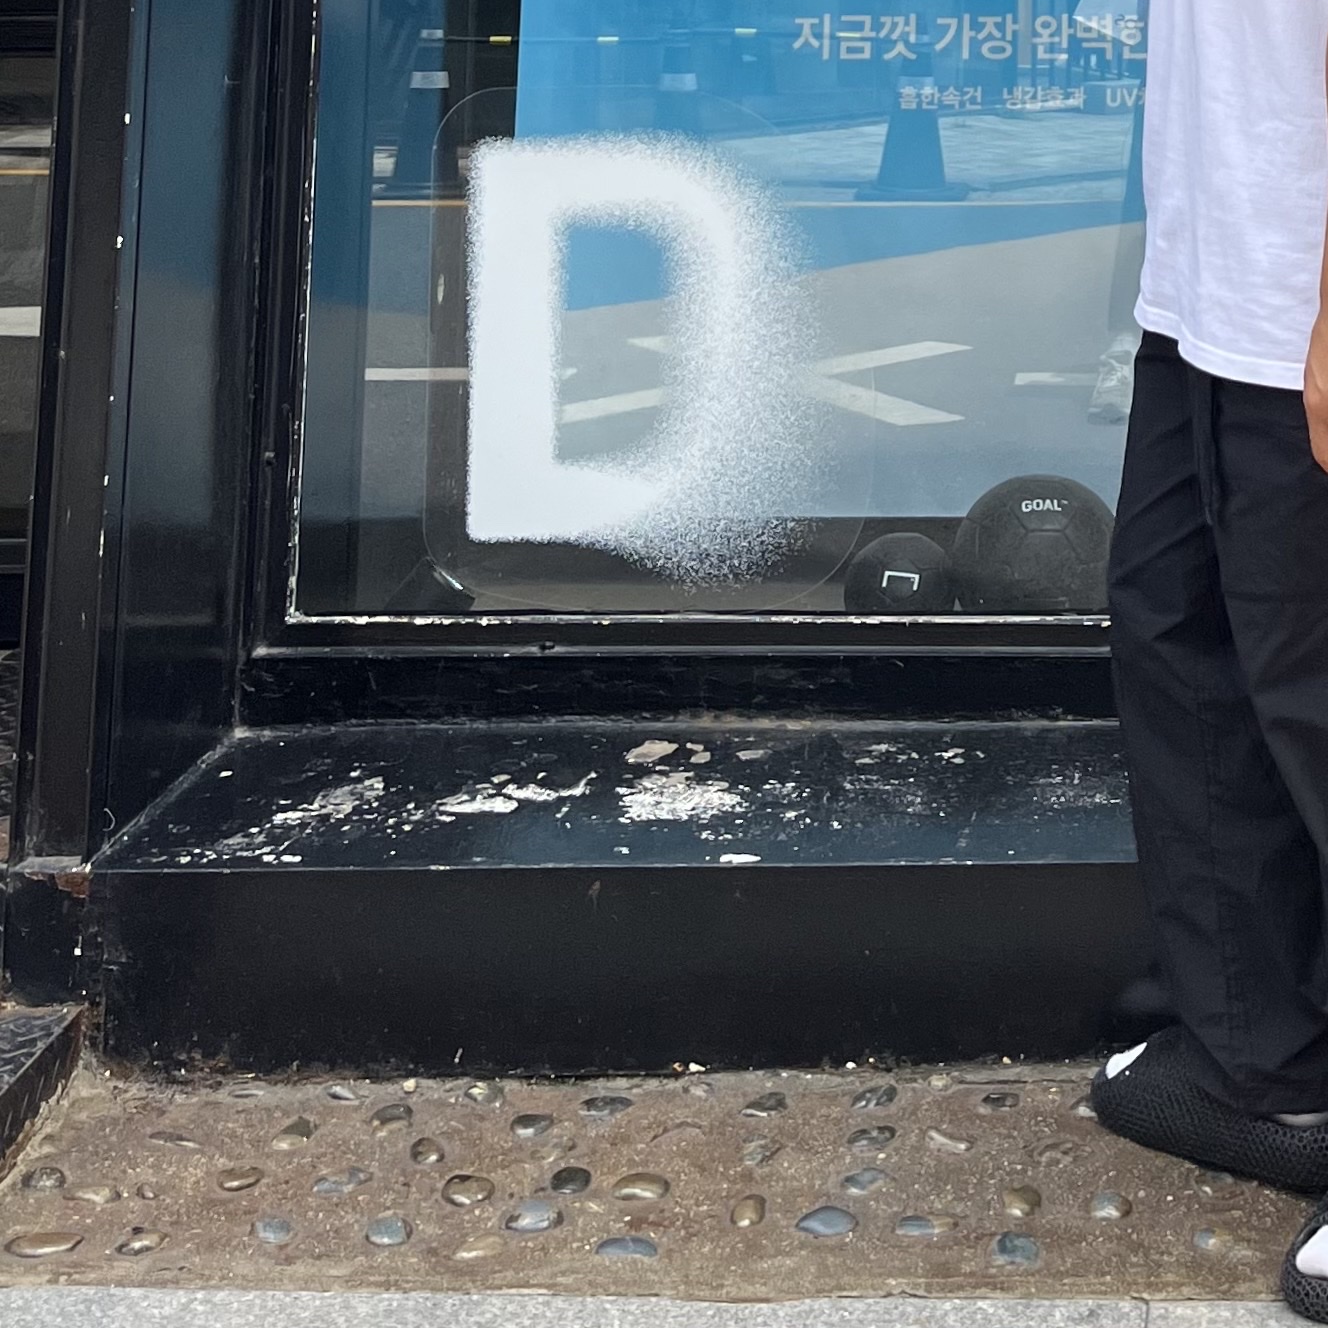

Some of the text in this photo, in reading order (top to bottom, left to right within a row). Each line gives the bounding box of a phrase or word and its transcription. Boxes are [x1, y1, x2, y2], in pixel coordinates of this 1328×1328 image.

[792, 13, 918, 61] 지금껏
[934, 13, 1020, 61] 가장
[1021, 498, 1063, 513] GOAL
